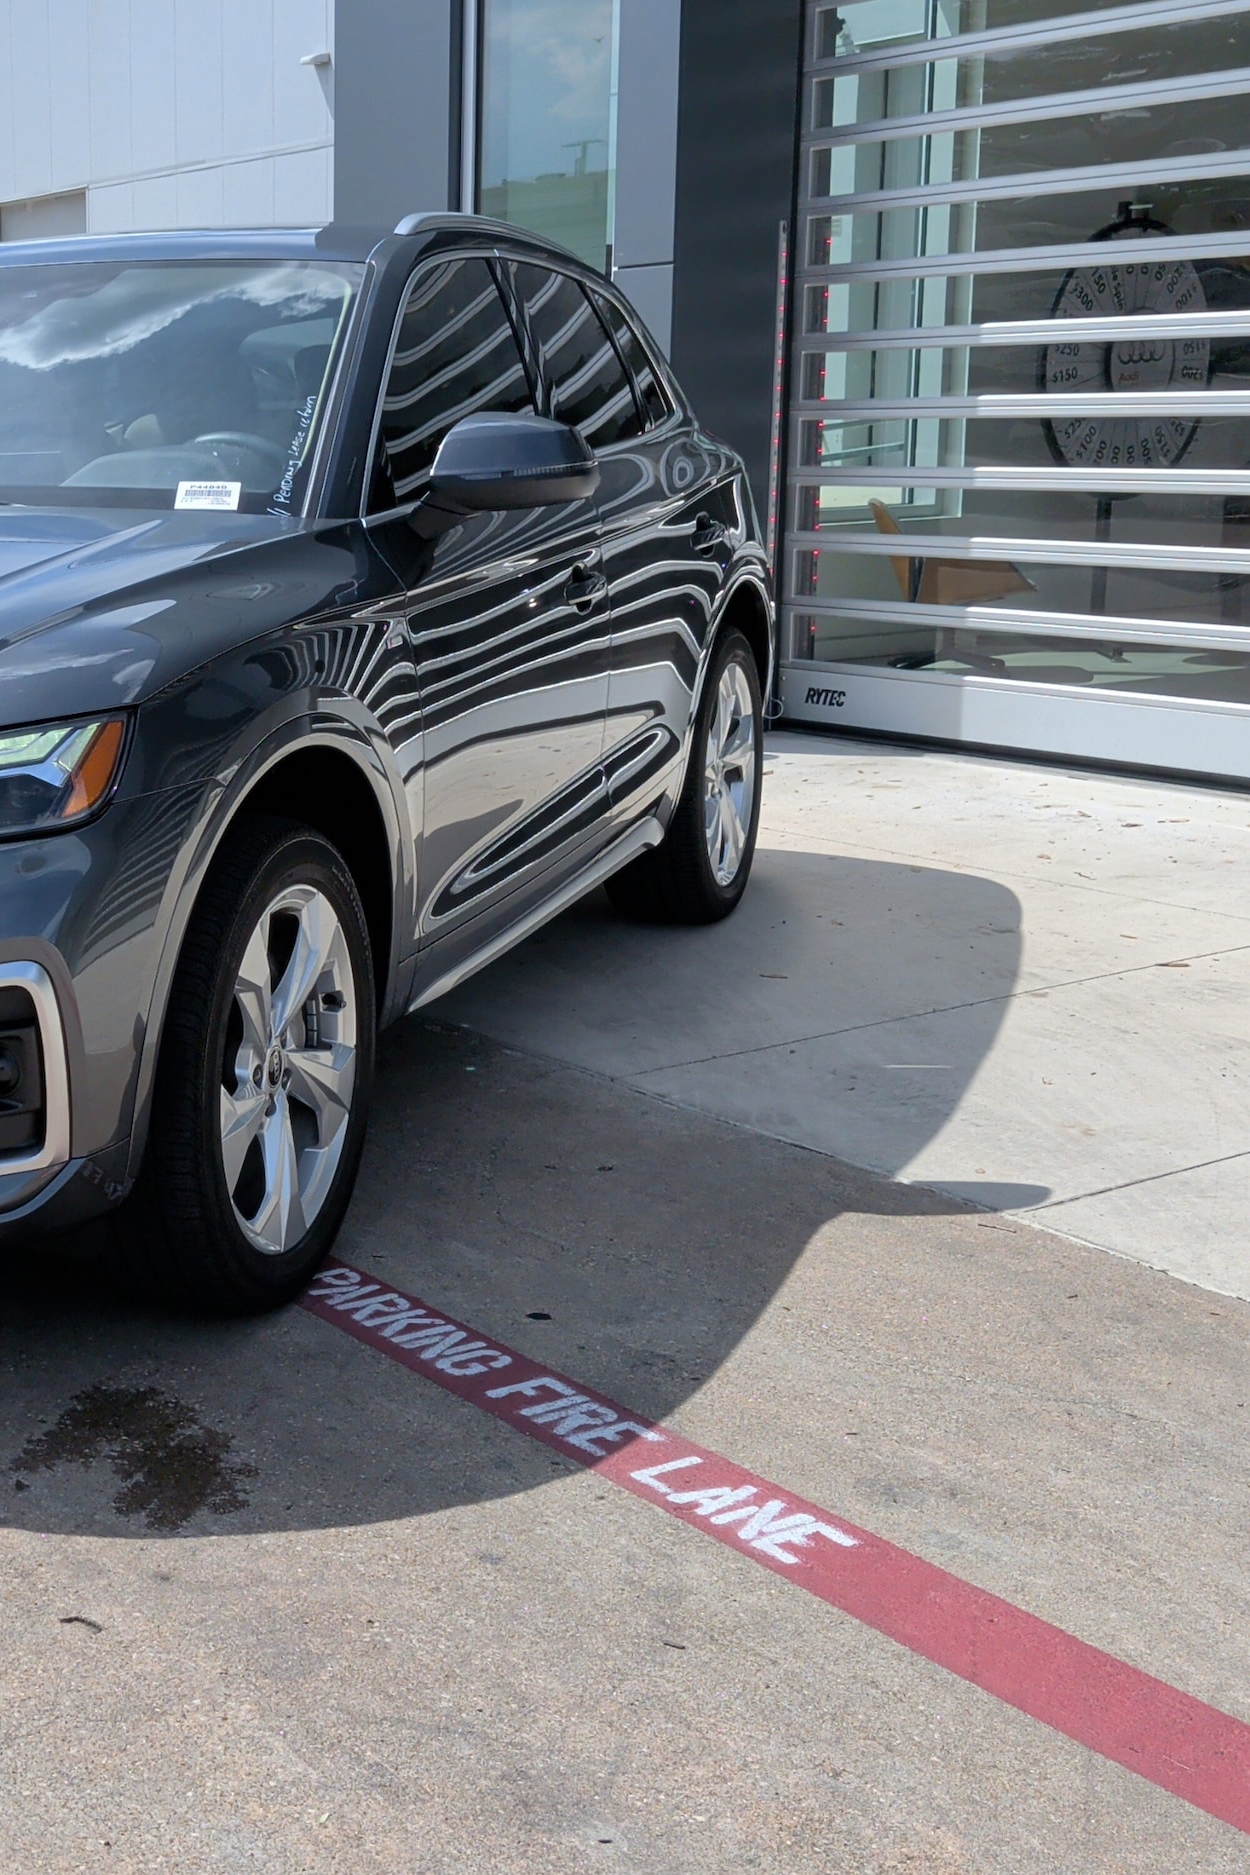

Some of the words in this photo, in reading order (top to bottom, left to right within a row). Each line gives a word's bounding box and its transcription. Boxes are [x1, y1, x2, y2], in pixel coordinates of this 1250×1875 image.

[1092, 266, 1106, 294] 150
[804, 687, 846, 707] RYTEC
[309, 1267, 512, 1377] PARKING
[485, 1377, 665, 1457] FIRE
[630, 1456, 860, 1564] LANE
